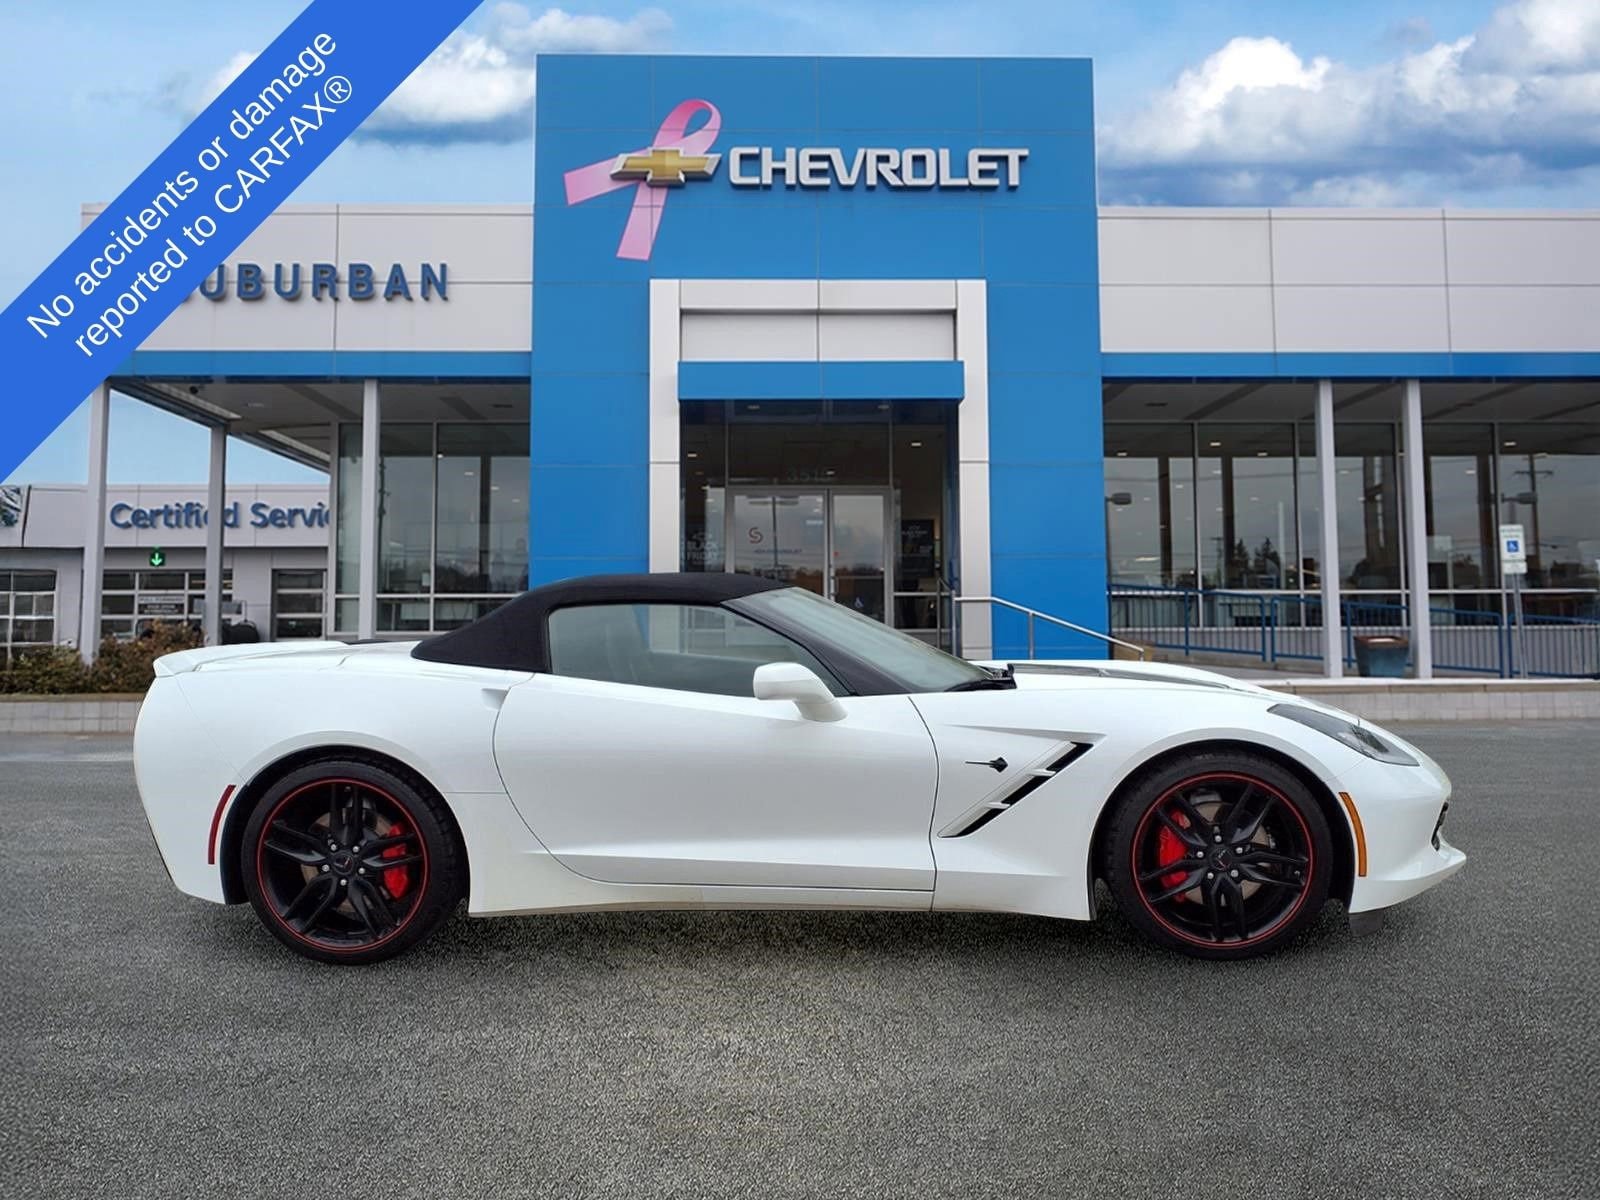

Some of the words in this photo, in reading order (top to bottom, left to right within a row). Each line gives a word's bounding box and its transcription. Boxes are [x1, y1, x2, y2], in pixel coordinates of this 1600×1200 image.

[729, 147, 1030, 187] CHEVROLET
[196, 262, 449, 301] UBURBAN
[109, 501, 240, 529] Certifid
